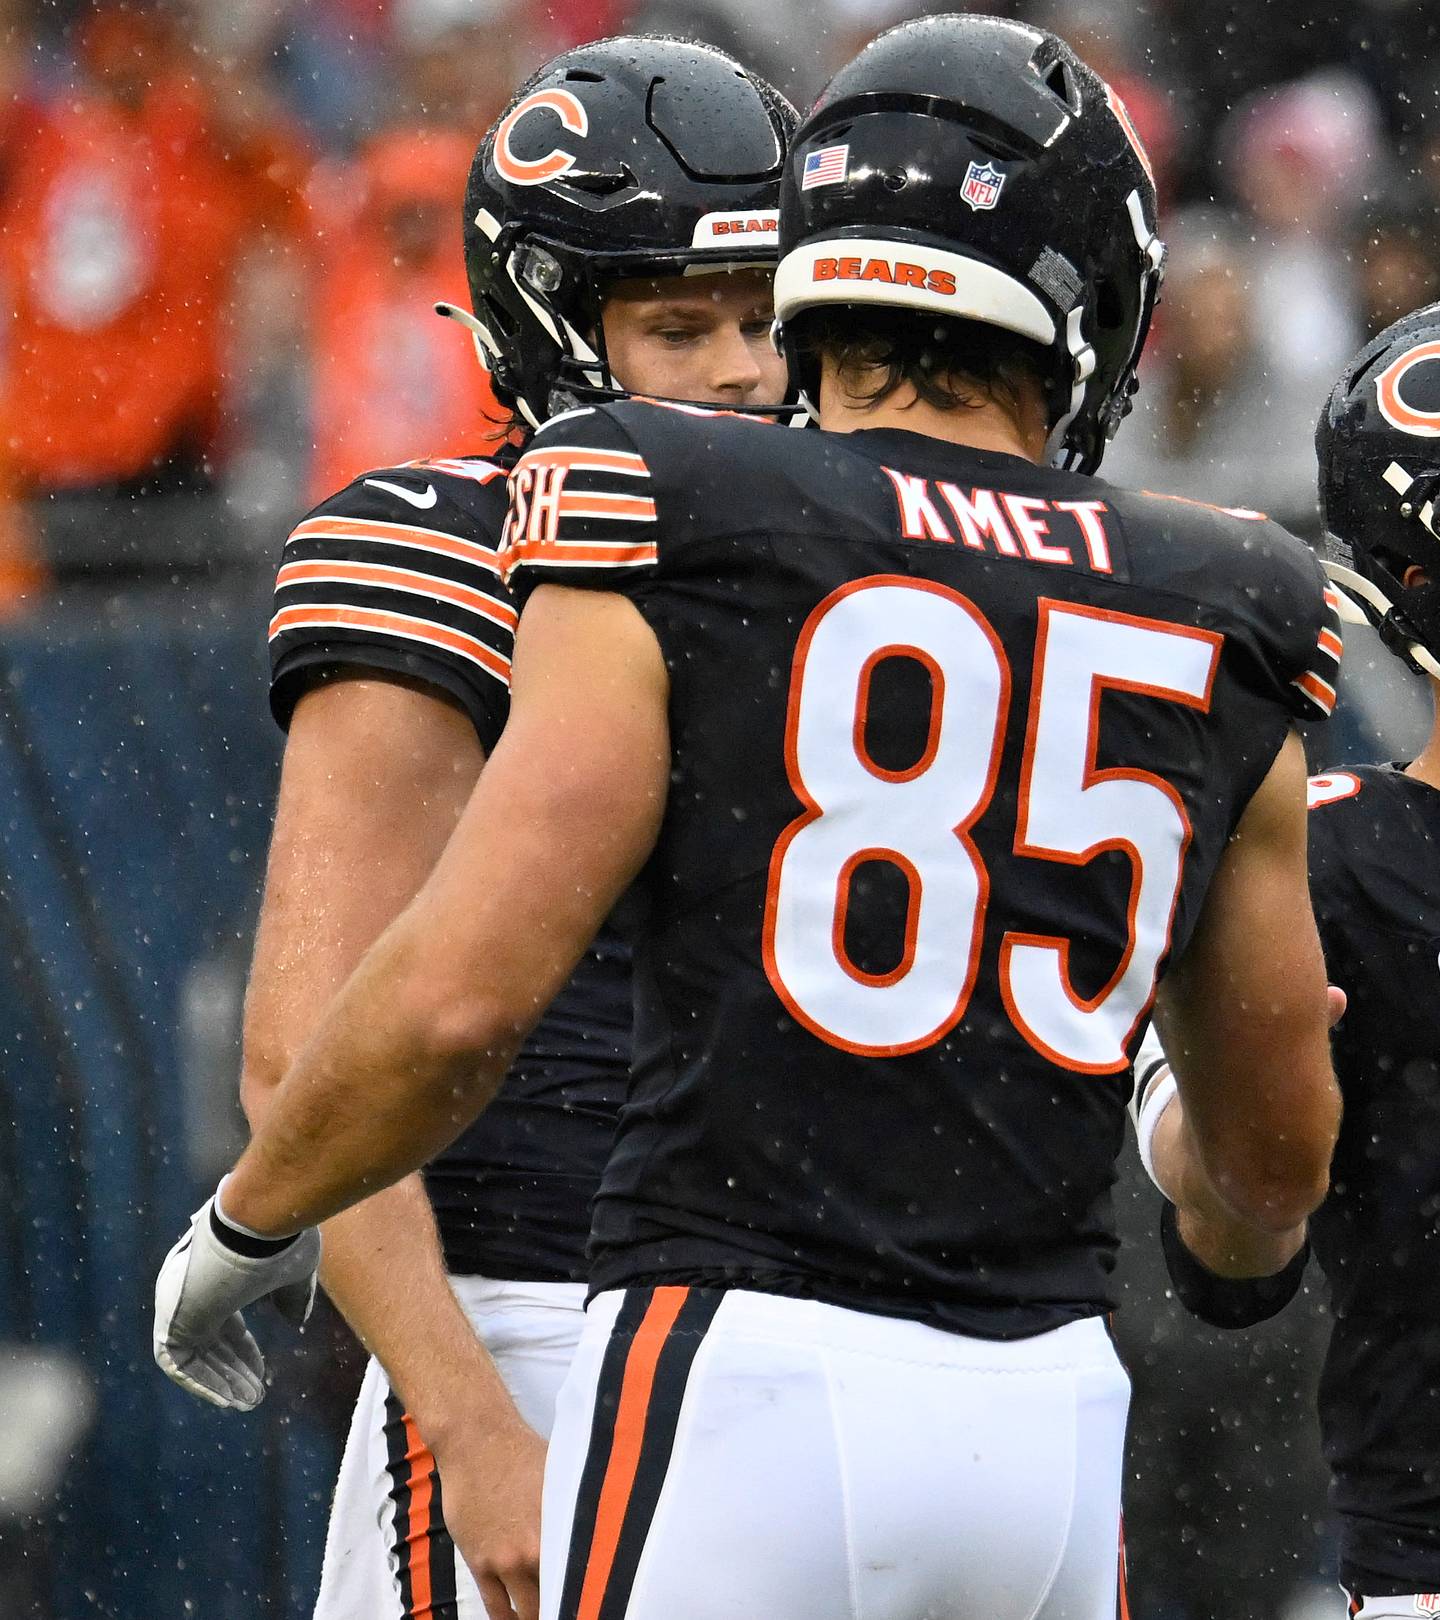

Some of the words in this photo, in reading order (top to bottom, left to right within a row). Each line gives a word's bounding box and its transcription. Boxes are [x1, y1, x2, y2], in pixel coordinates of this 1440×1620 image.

[493, 88, 588, 185] C
[712, 219, 778, 235] BEAR
[965, 181, 993, 205] NFL
[813, 257, 957, 296] BEARS
[498, 465, 571, 552] SH
[879, 465, 1113, 575] KMET
[762, 574, 1224, 1075] 85
